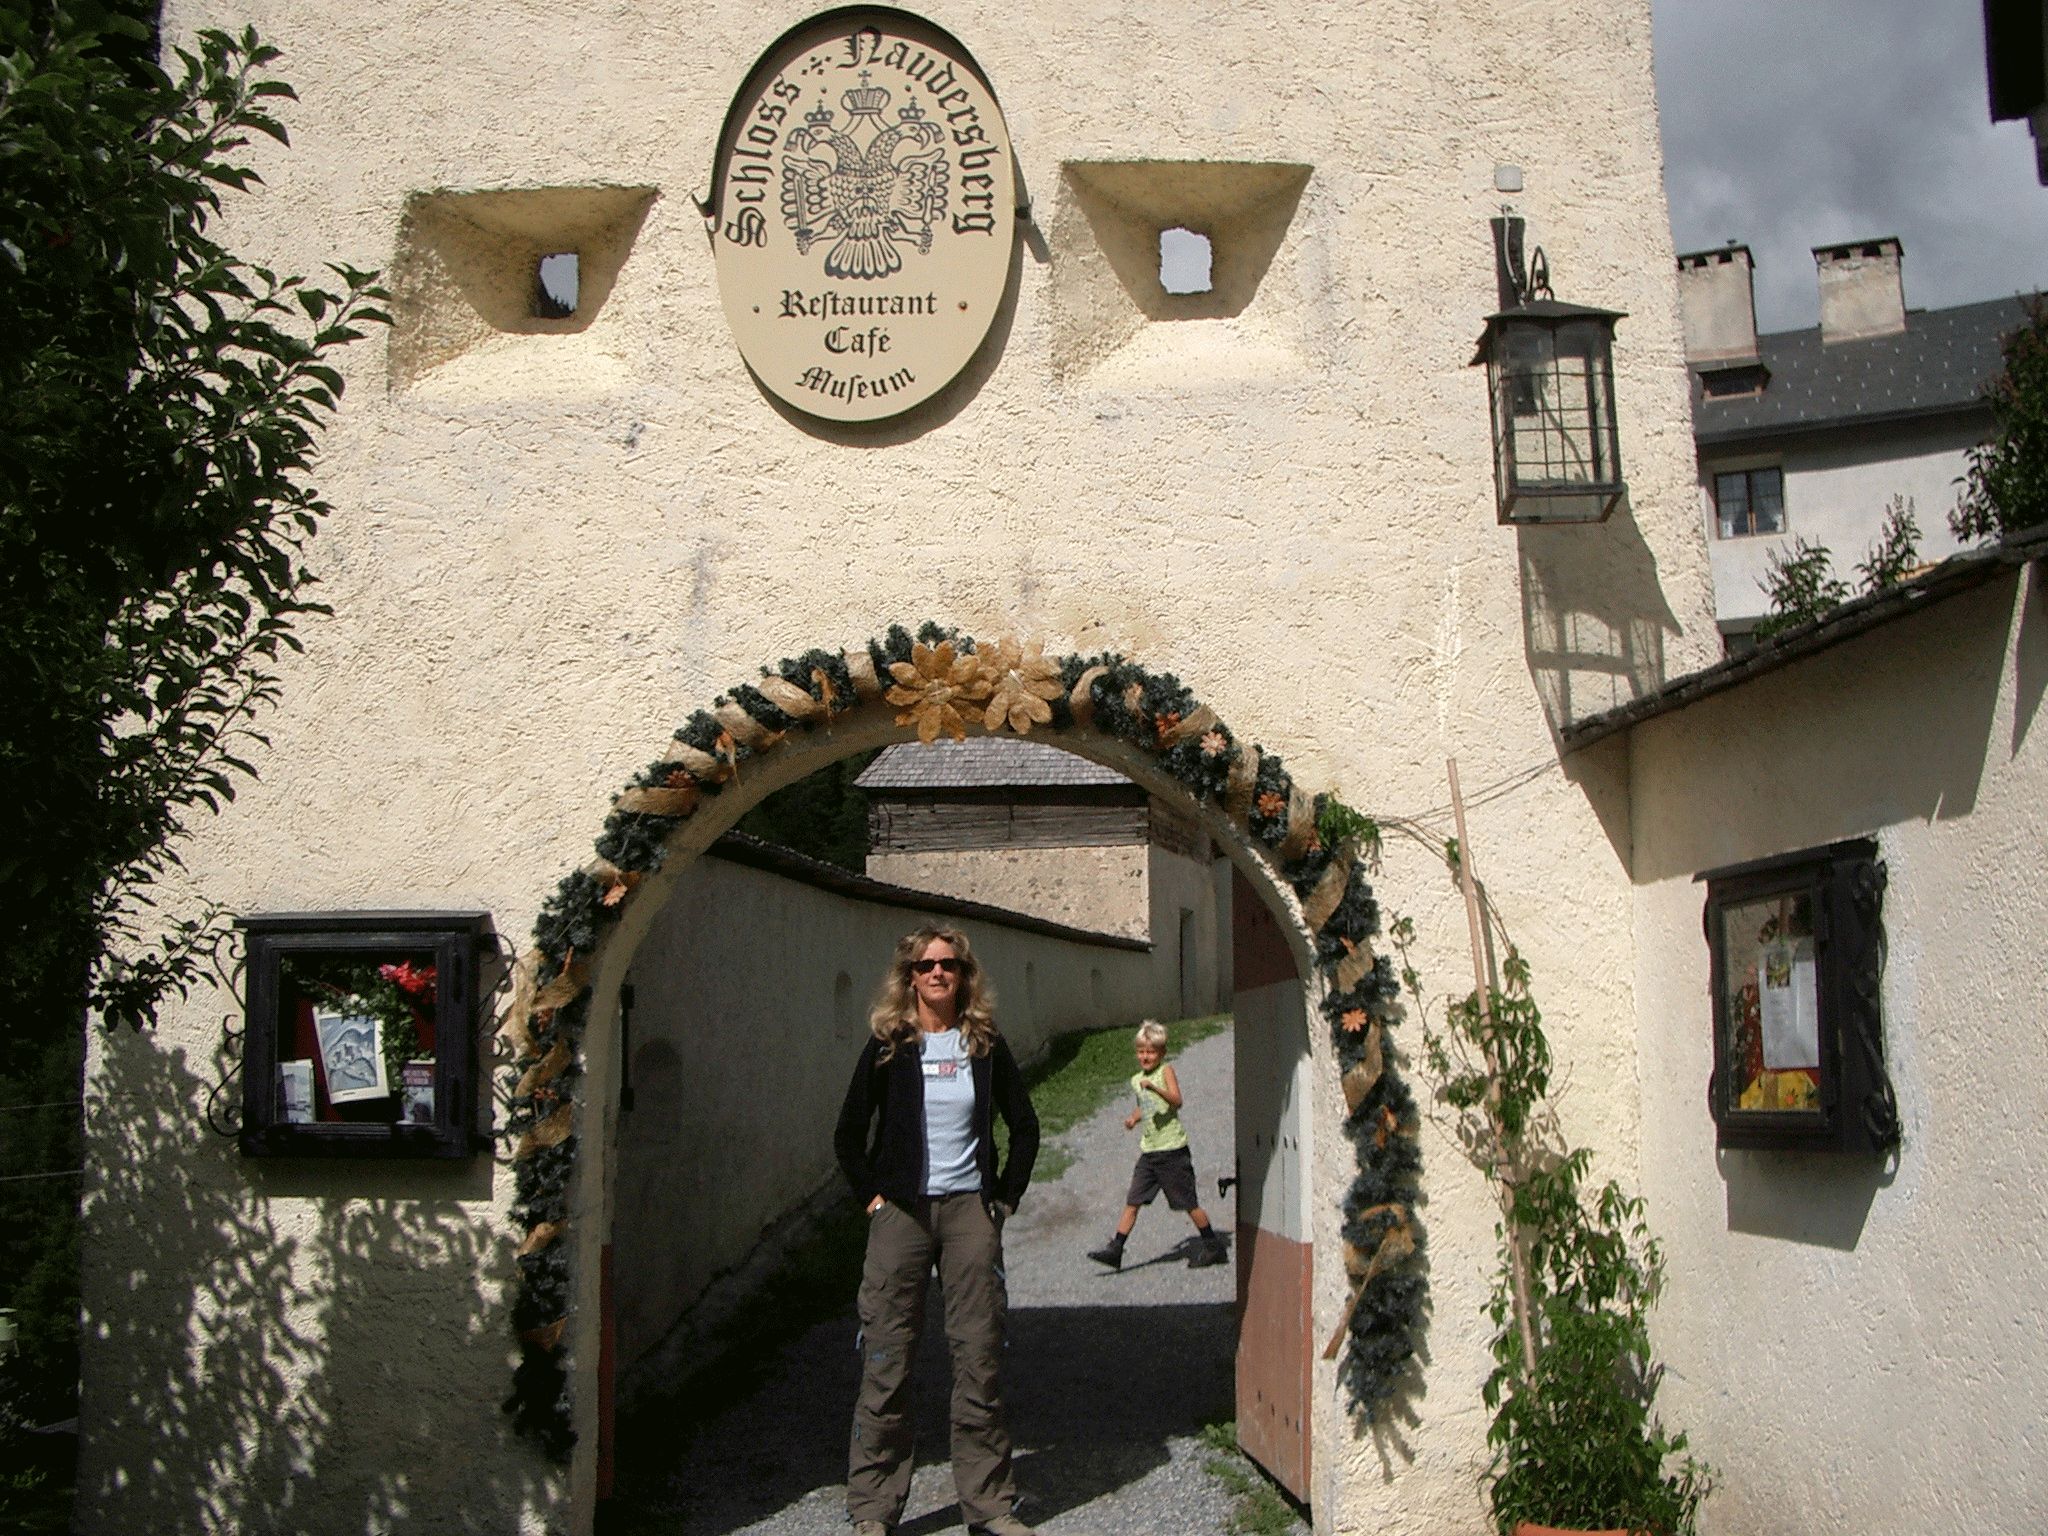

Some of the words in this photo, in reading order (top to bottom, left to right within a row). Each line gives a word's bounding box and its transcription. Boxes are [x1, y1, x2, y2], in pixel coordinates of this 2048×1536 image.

[725, 73, 802, 248] Schloss
[836, 26, 1002, 237] Naudersberg
[778, 289, 938, 320] Restaurant
[824, 326, 891, 358] Café
[795, 365, 917, 405] Museum
